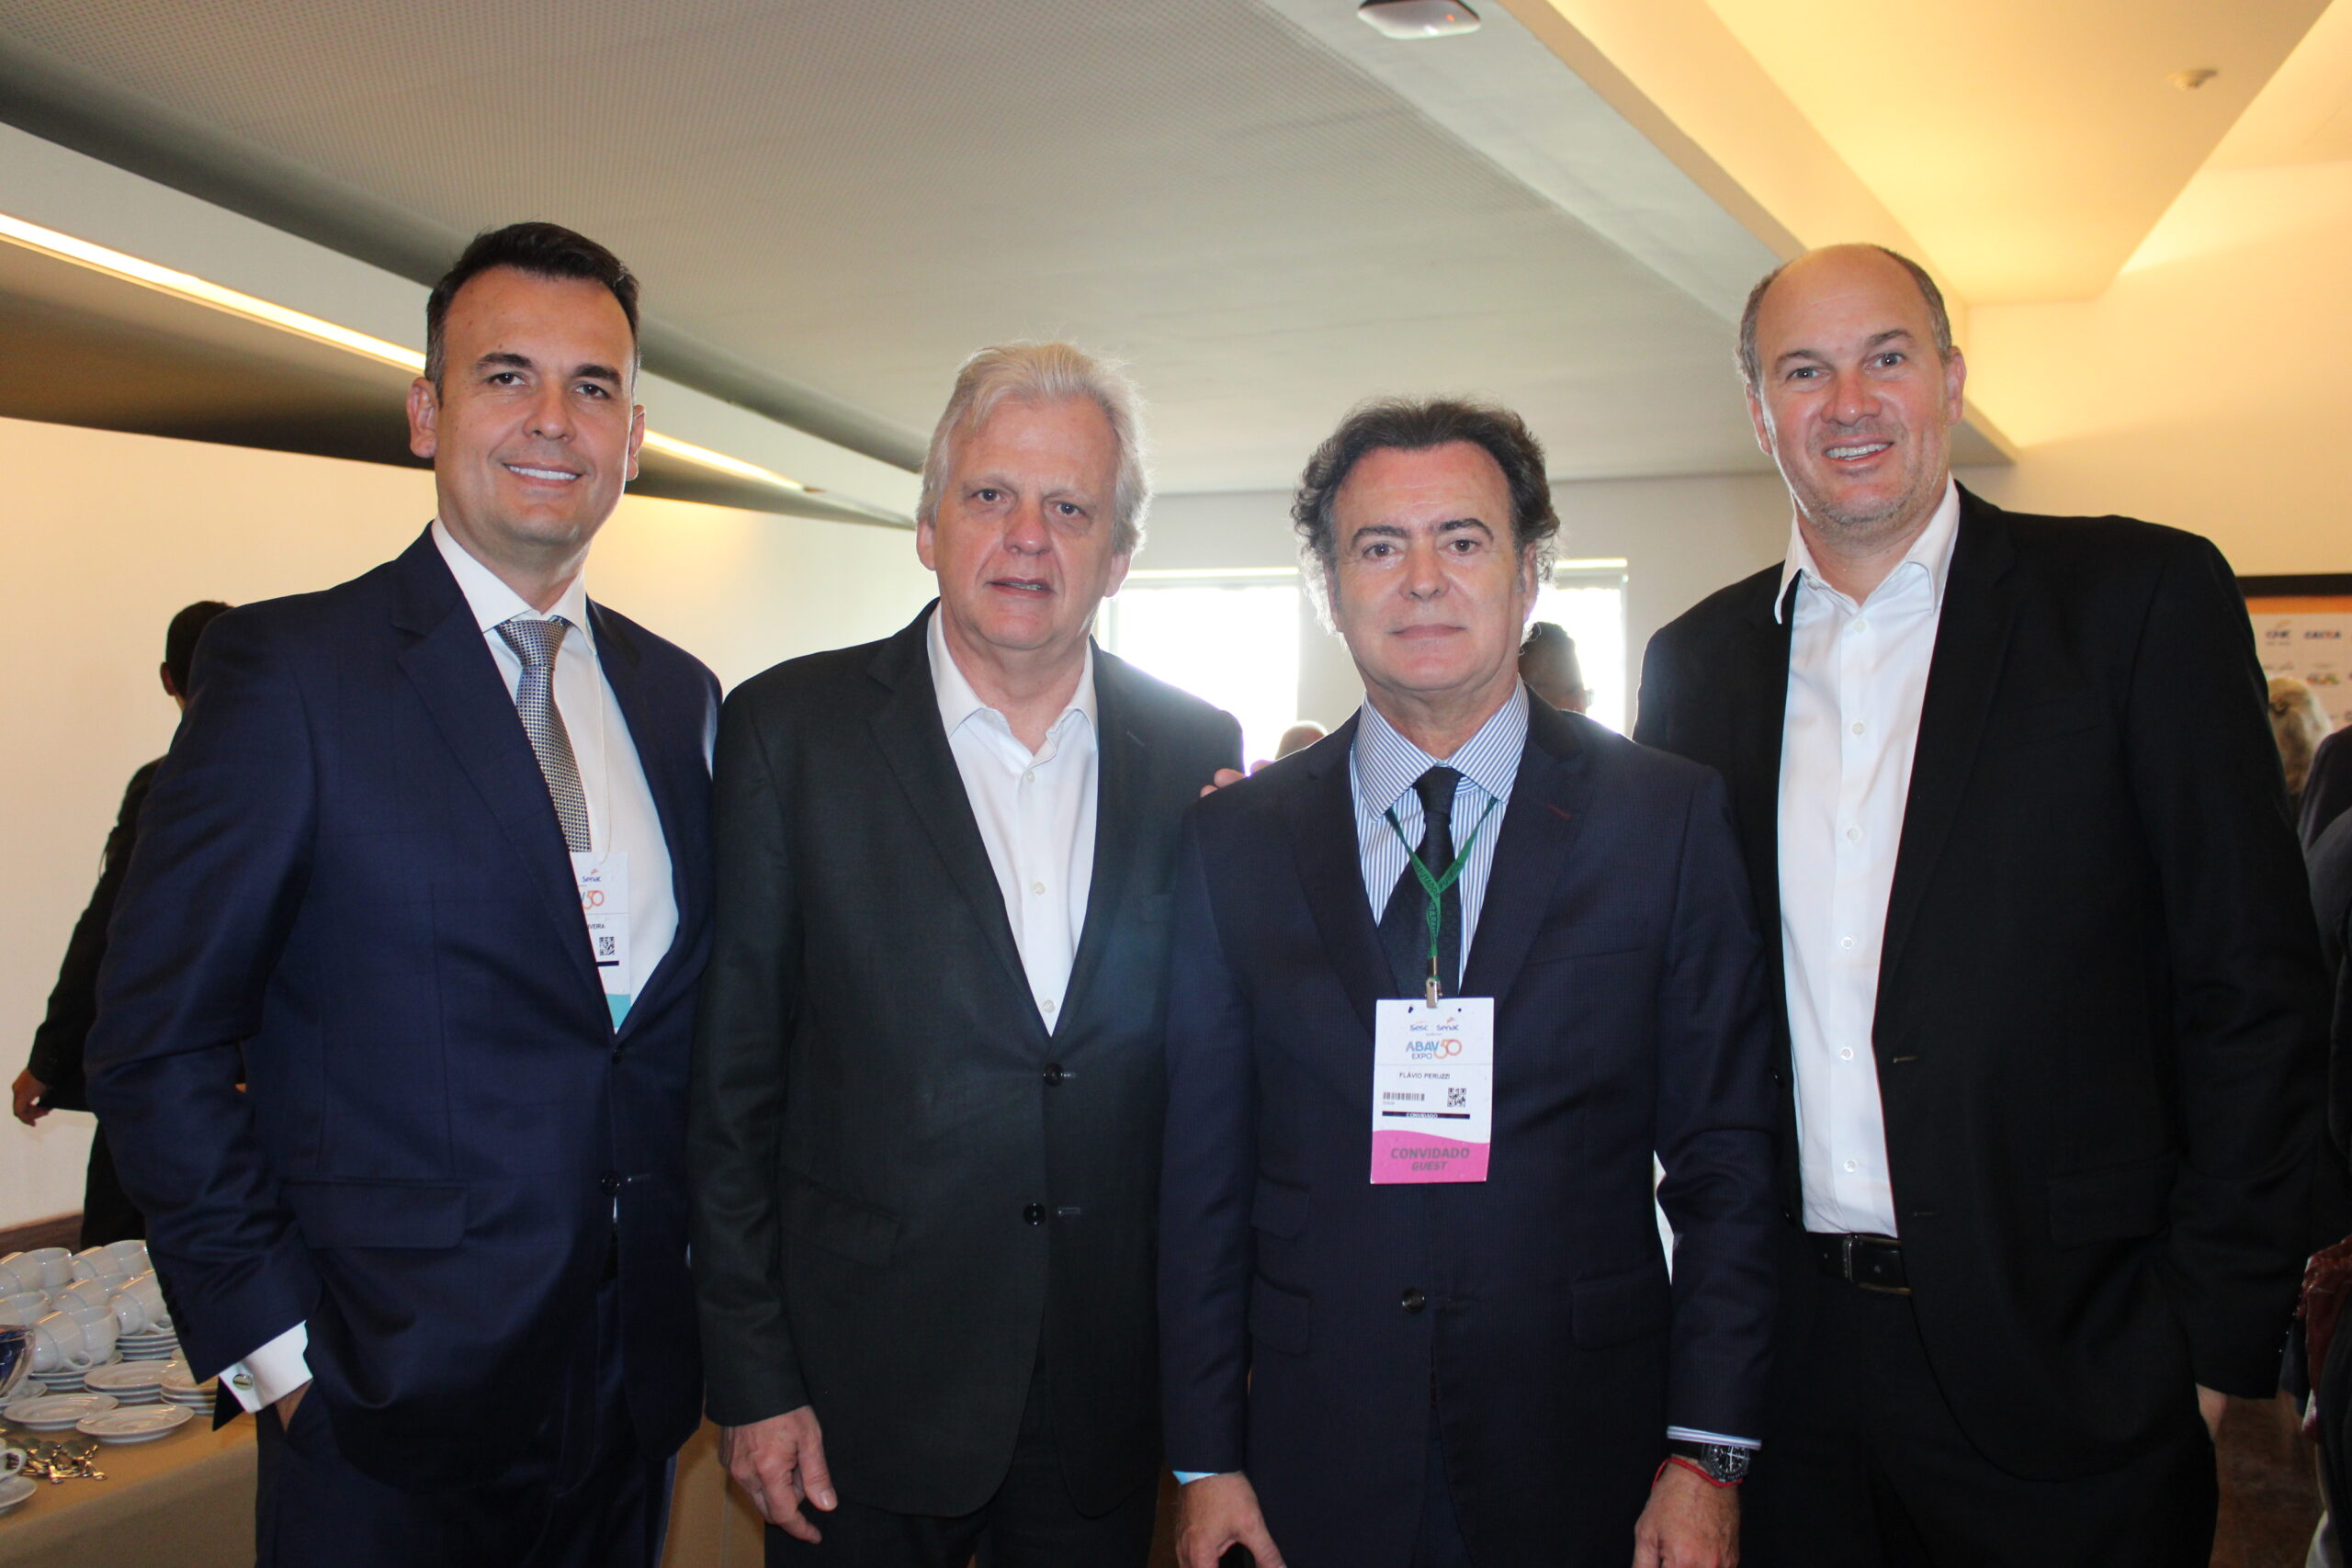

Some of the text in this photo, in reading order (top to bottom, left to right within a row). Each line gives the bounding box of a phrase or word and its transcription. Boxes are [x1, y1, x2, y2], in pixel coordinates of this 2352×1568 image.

[1406, 1041, 1439, 1052] ABAV
[1411, 1052, 1433, 1060] EXPO
[1399, 1070, 1422, 1078] FLÁVIO
[1390, 1146, 1470, 1159] CONVIDADO
[1411, 1161, 1448, 1171] GUEST
